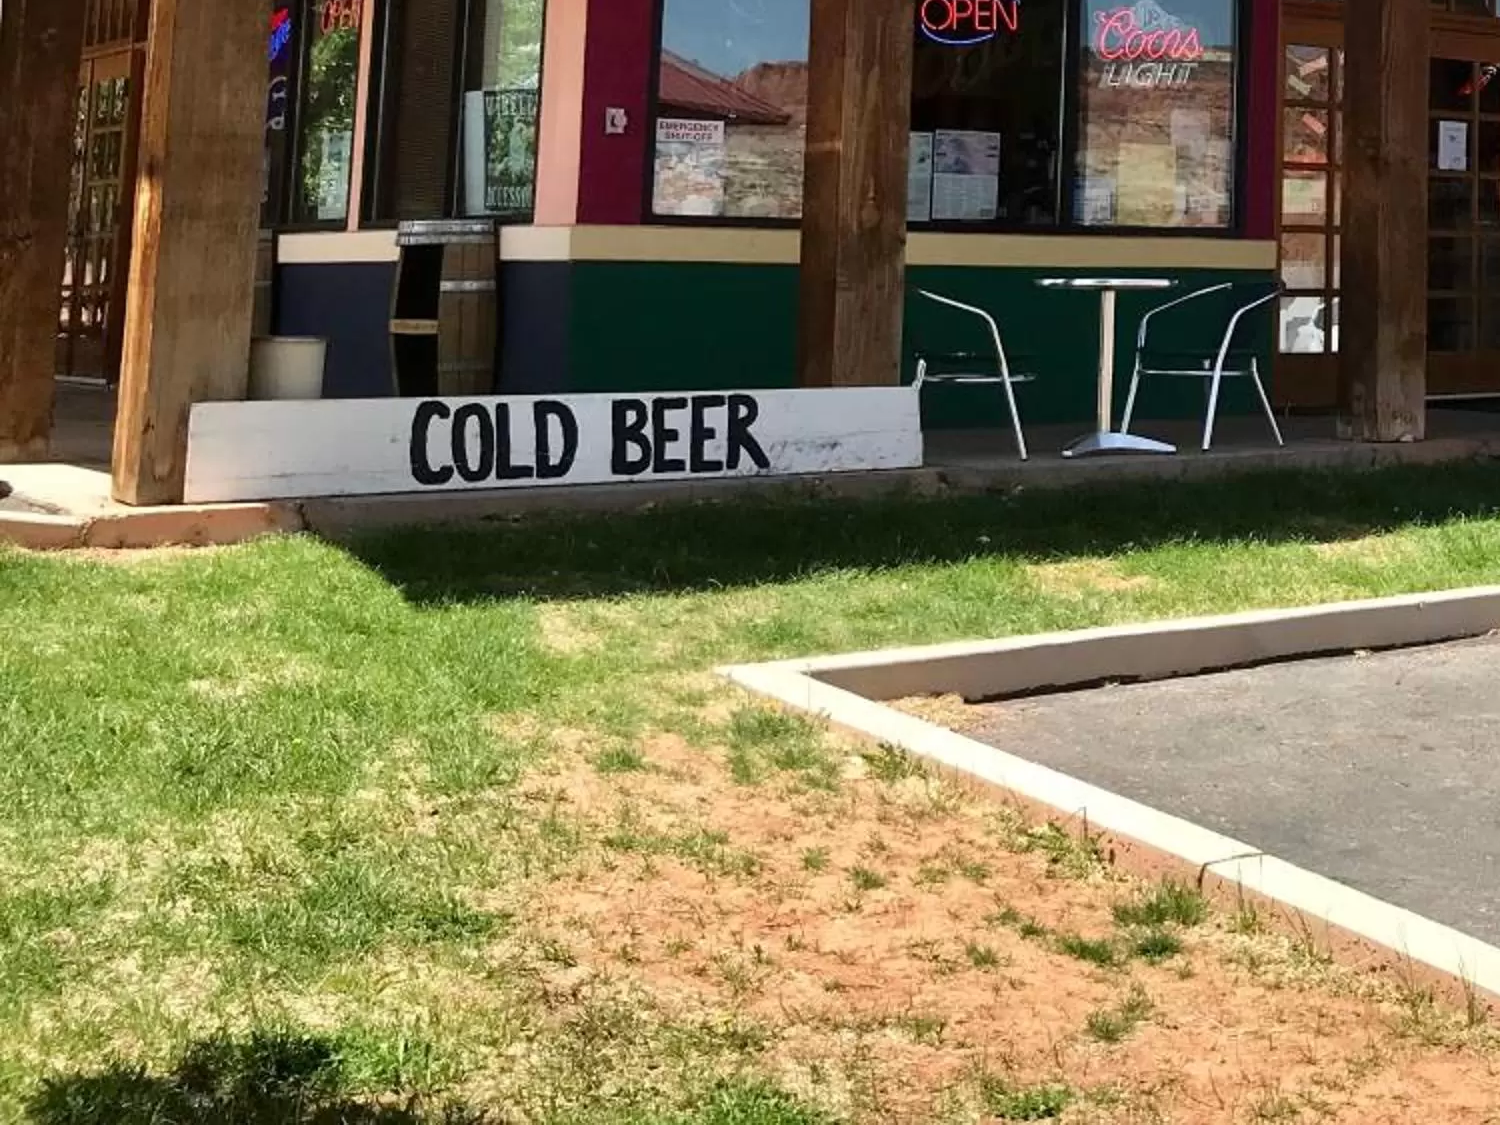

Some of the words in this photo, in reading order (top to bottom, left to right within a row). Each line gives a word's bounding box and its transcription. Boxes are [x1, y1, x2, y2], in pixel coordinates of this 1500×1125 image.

[1093, 6, 1204, 59] Coors
[1100, 62, 1198, 87] LIGHT
[410, 400, 579, 485] COLD
[611, 394, 771, 475] BEER
